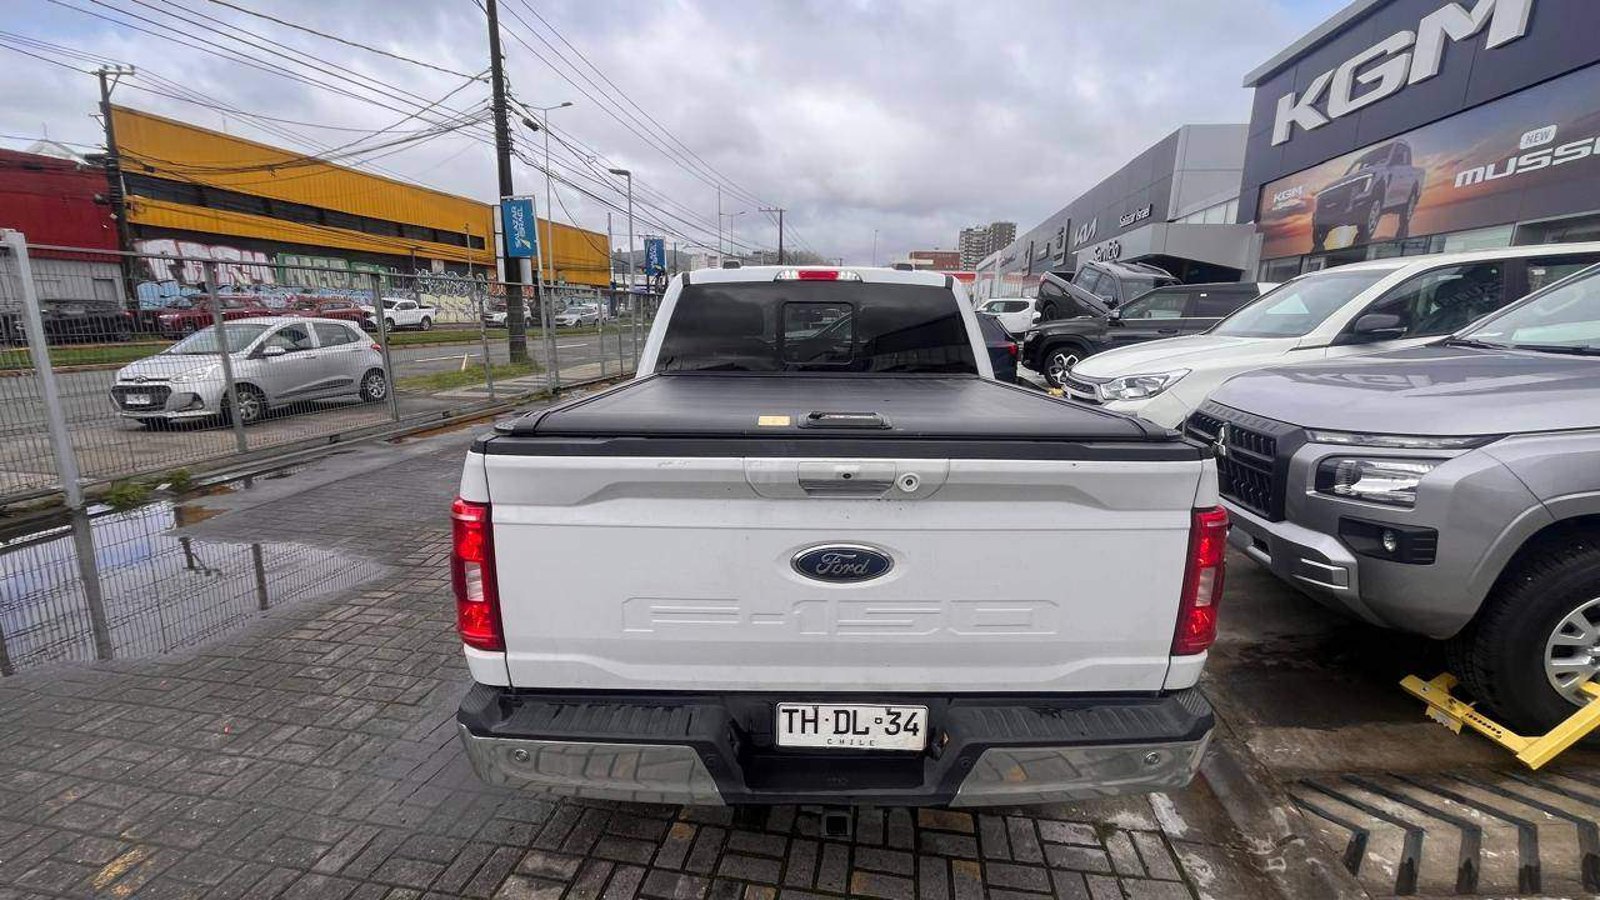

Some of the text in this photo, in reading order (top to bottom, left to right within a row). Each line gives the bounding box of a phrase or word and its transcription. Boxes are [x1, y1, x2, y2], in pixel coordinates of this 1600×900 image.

[1271, 0, 1534, 147] KGM
[1525, 129, 1550, 145] NEW
[1454, 136, 1600, 188] MUSS
[816, 552, 870, 575] Ford
[622, 597, 1058, 636] F-150
[826, 738, 876, 747] CHILE
